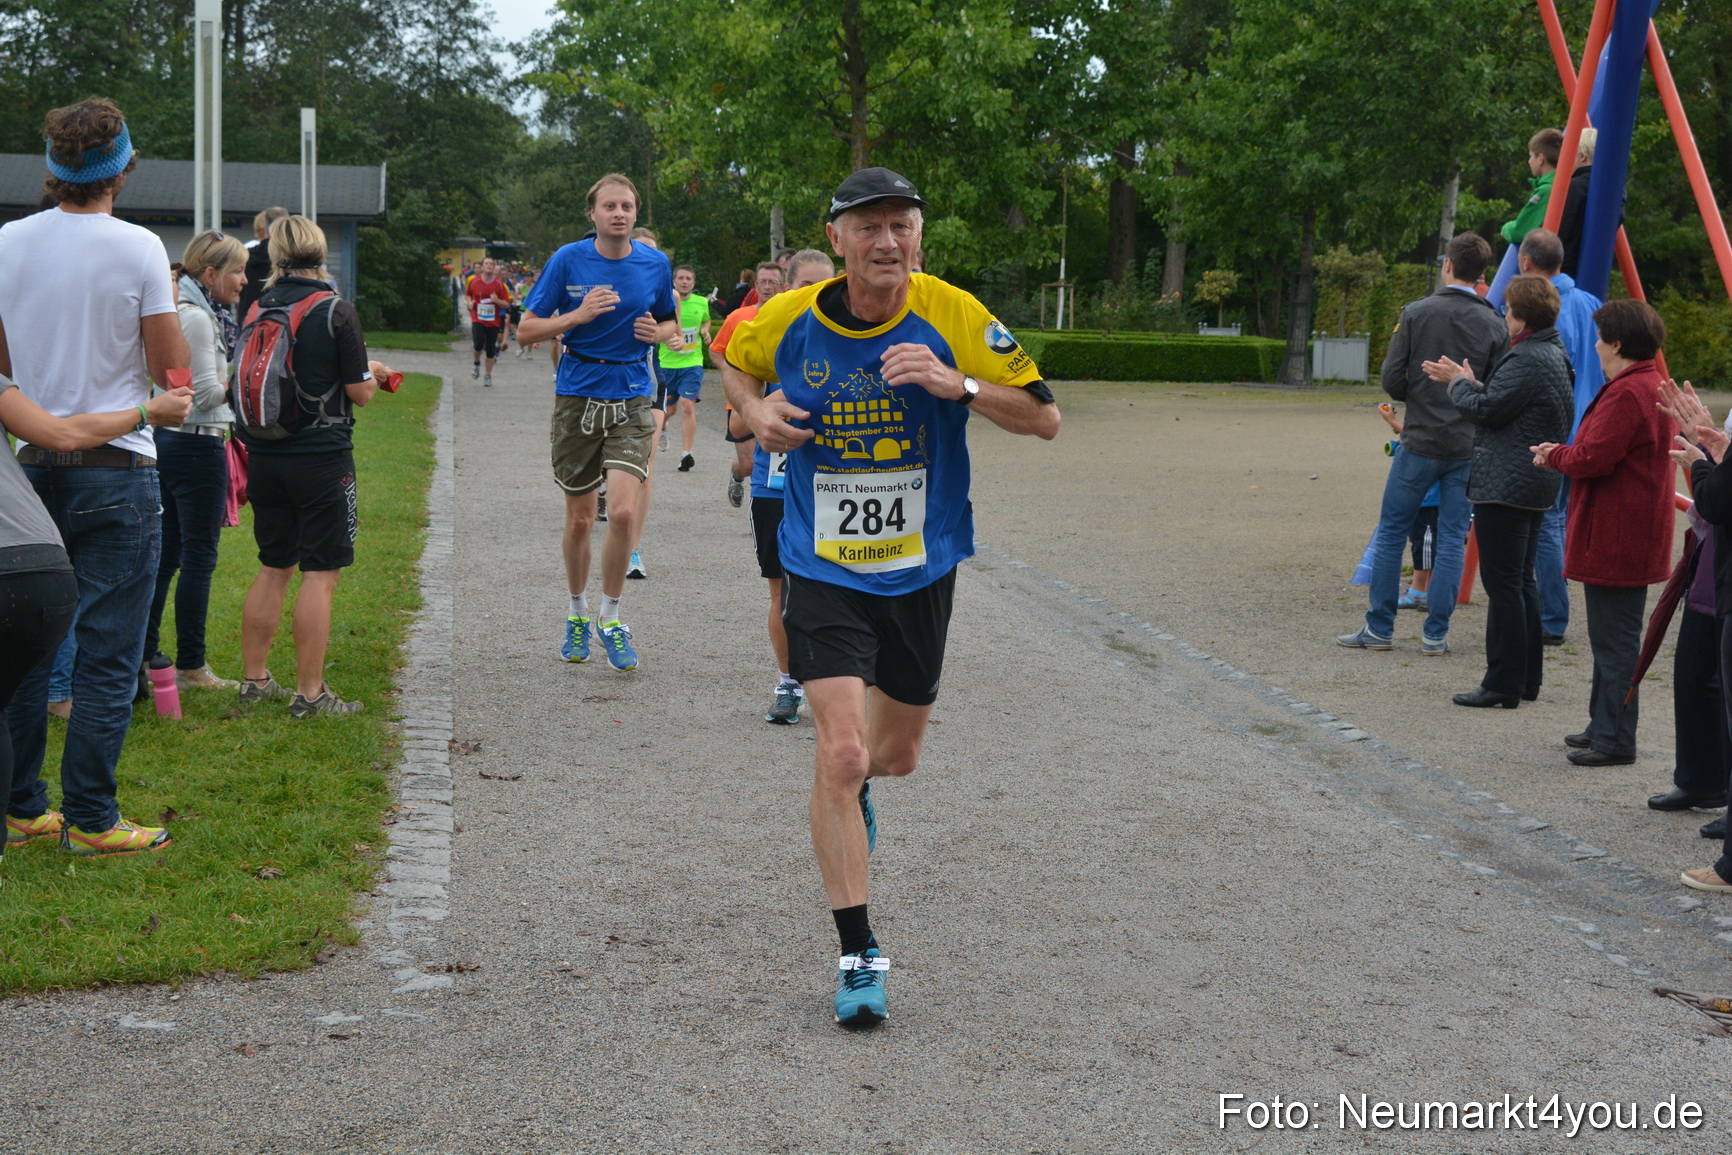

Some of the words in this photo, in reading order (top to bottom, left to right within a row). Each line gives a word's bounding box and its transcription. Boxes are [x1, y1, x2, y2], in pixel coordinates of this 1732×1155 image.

[825, 428, 881, 438] 21.September
[884, 425, 905, 434] 2014
[816, 463, 924, 473] www.stadtlauf-neumarkt.de
[816, 483, 852, 494] PARTL
[855, 482, 908, 494] Neumarkt
[838, 497, 906, 536] 284
[838, 544, 904, 561] Karlheinz
